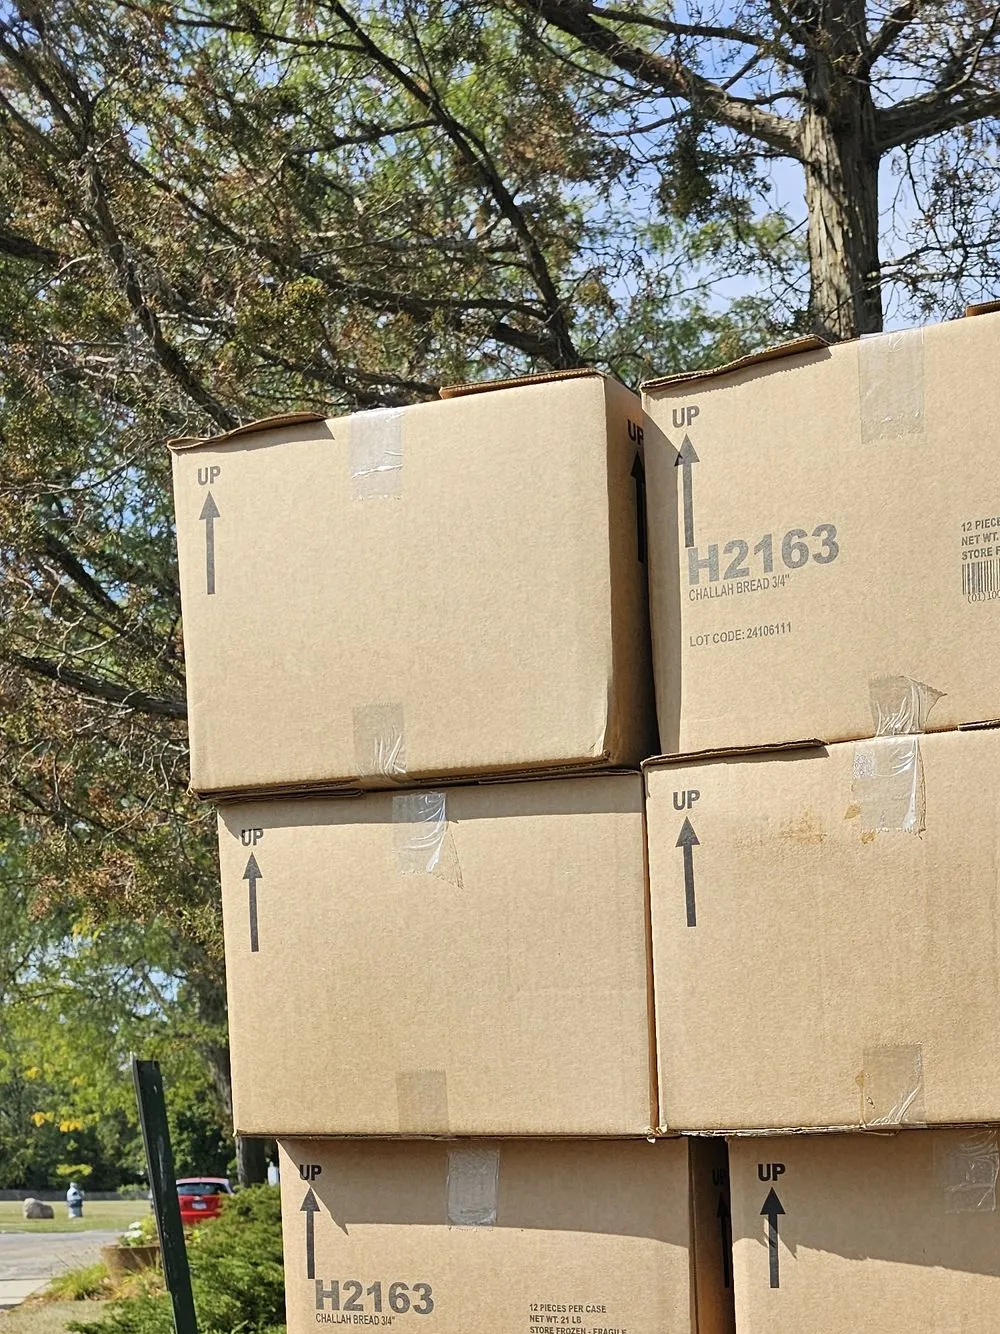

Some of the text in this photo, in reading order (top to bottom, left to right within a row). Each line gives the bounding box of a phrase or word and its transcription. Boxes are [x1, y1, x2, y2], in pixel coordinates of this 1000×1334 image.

[672, 405, 700, 428] UP
[627, 418, 643, 446] UP
[198, 466, 221, 485] UP
[961, 521, 972, 532] 12
[961, 534, 980, 546] NET
[982, 532, 999, 543] WT.
[687, 523, 840, 585] H2163
[961, 549, 993, 561] STORE
[688, 574, 790, 602] CHALLAH BREAD 3/4"
[690, 622, 792, 647] LOT CODE: 24106111
[672, 790, 700, 810] UP
[241, 828, 264, 846] UP
[299, 1164, 322, 1181] UP
[757, 1163, 786, 1182] UP
[315, 1279, 435, 1315] H2163
[529, 1303, 607, 1314] 12 PIECES PER CASE
[315, 1312, 396, 1326] CHALLAH BREAD 3/4"
[529, 1314, 582, 1324] NET WT. 21 LB
[530, 1326, 554, 1334] STORE
